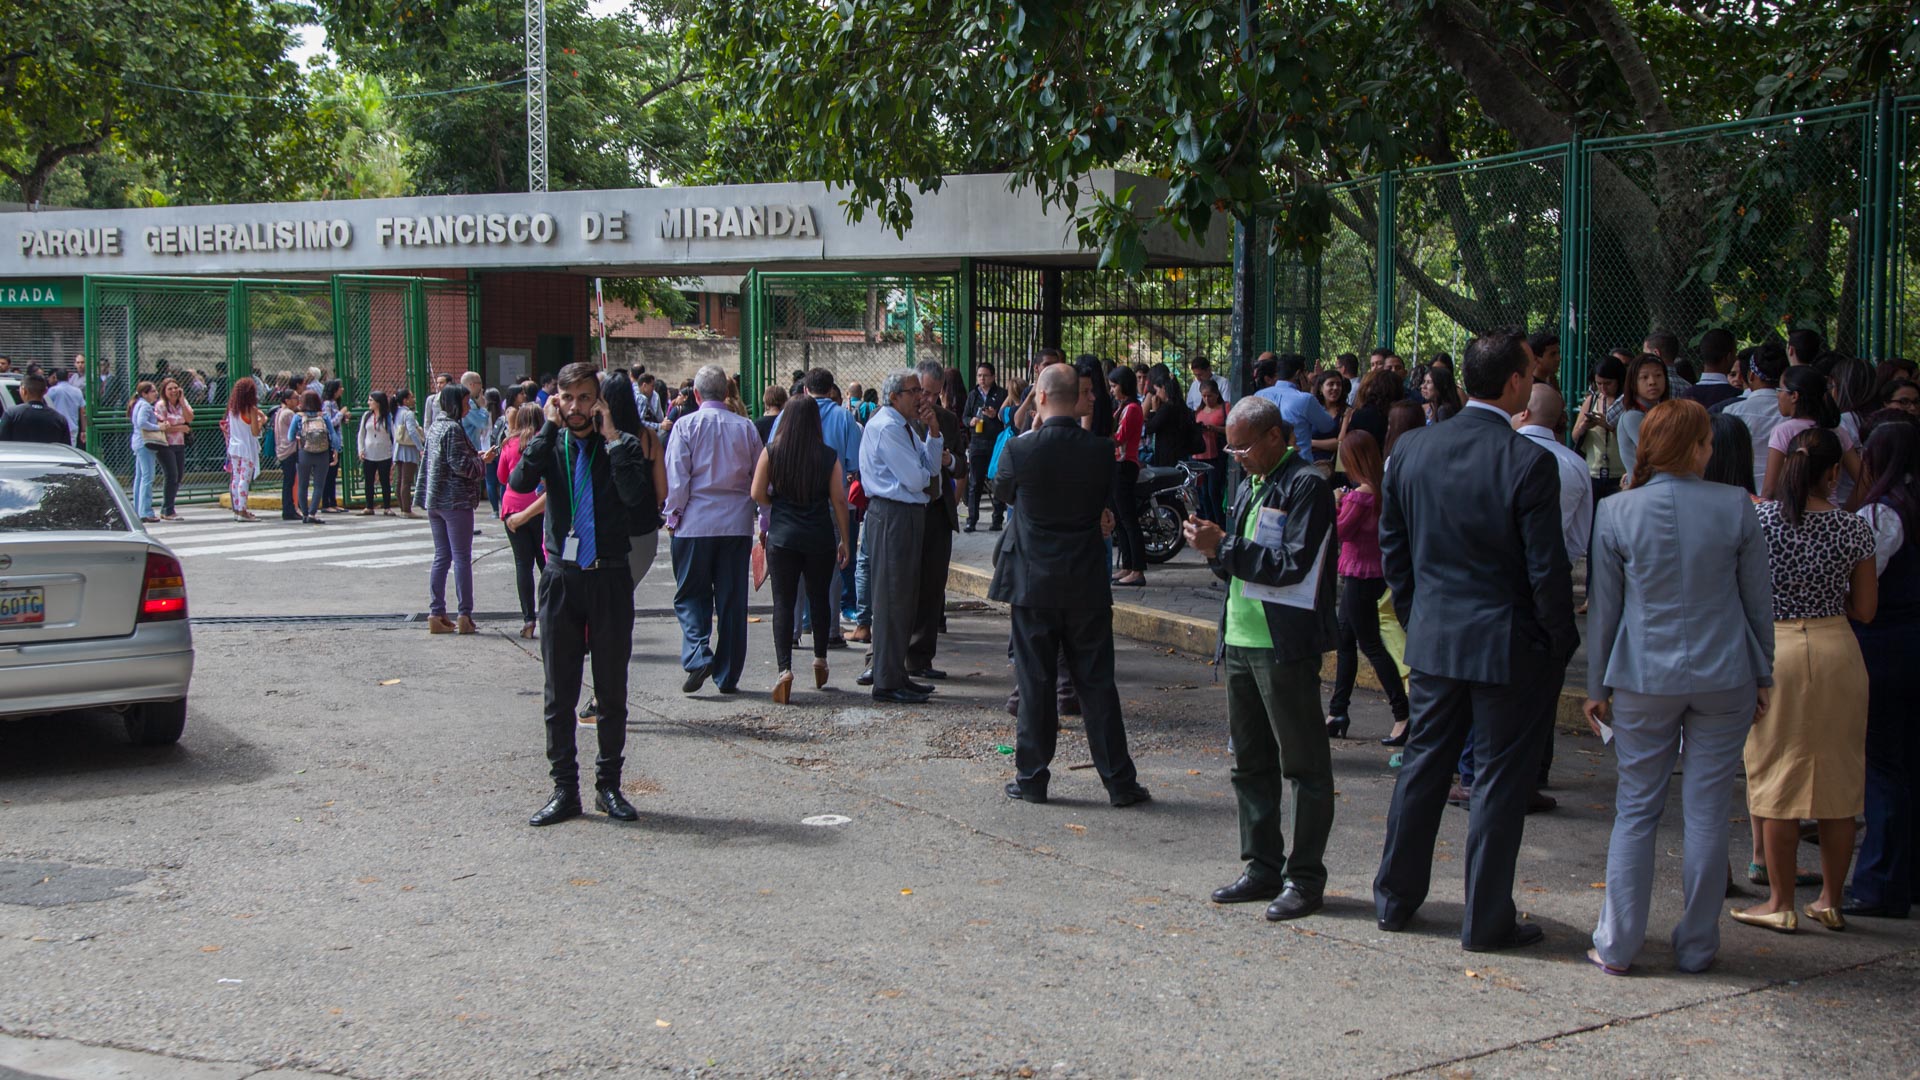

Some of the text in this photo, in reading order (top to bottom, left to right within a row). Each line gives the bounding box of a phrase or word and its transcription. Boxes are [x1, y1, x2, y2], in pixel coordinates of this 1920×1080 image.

[18, 203, 818, 257] PARQUE GENERALISIMO FRANCISCO DE MIRANDA
